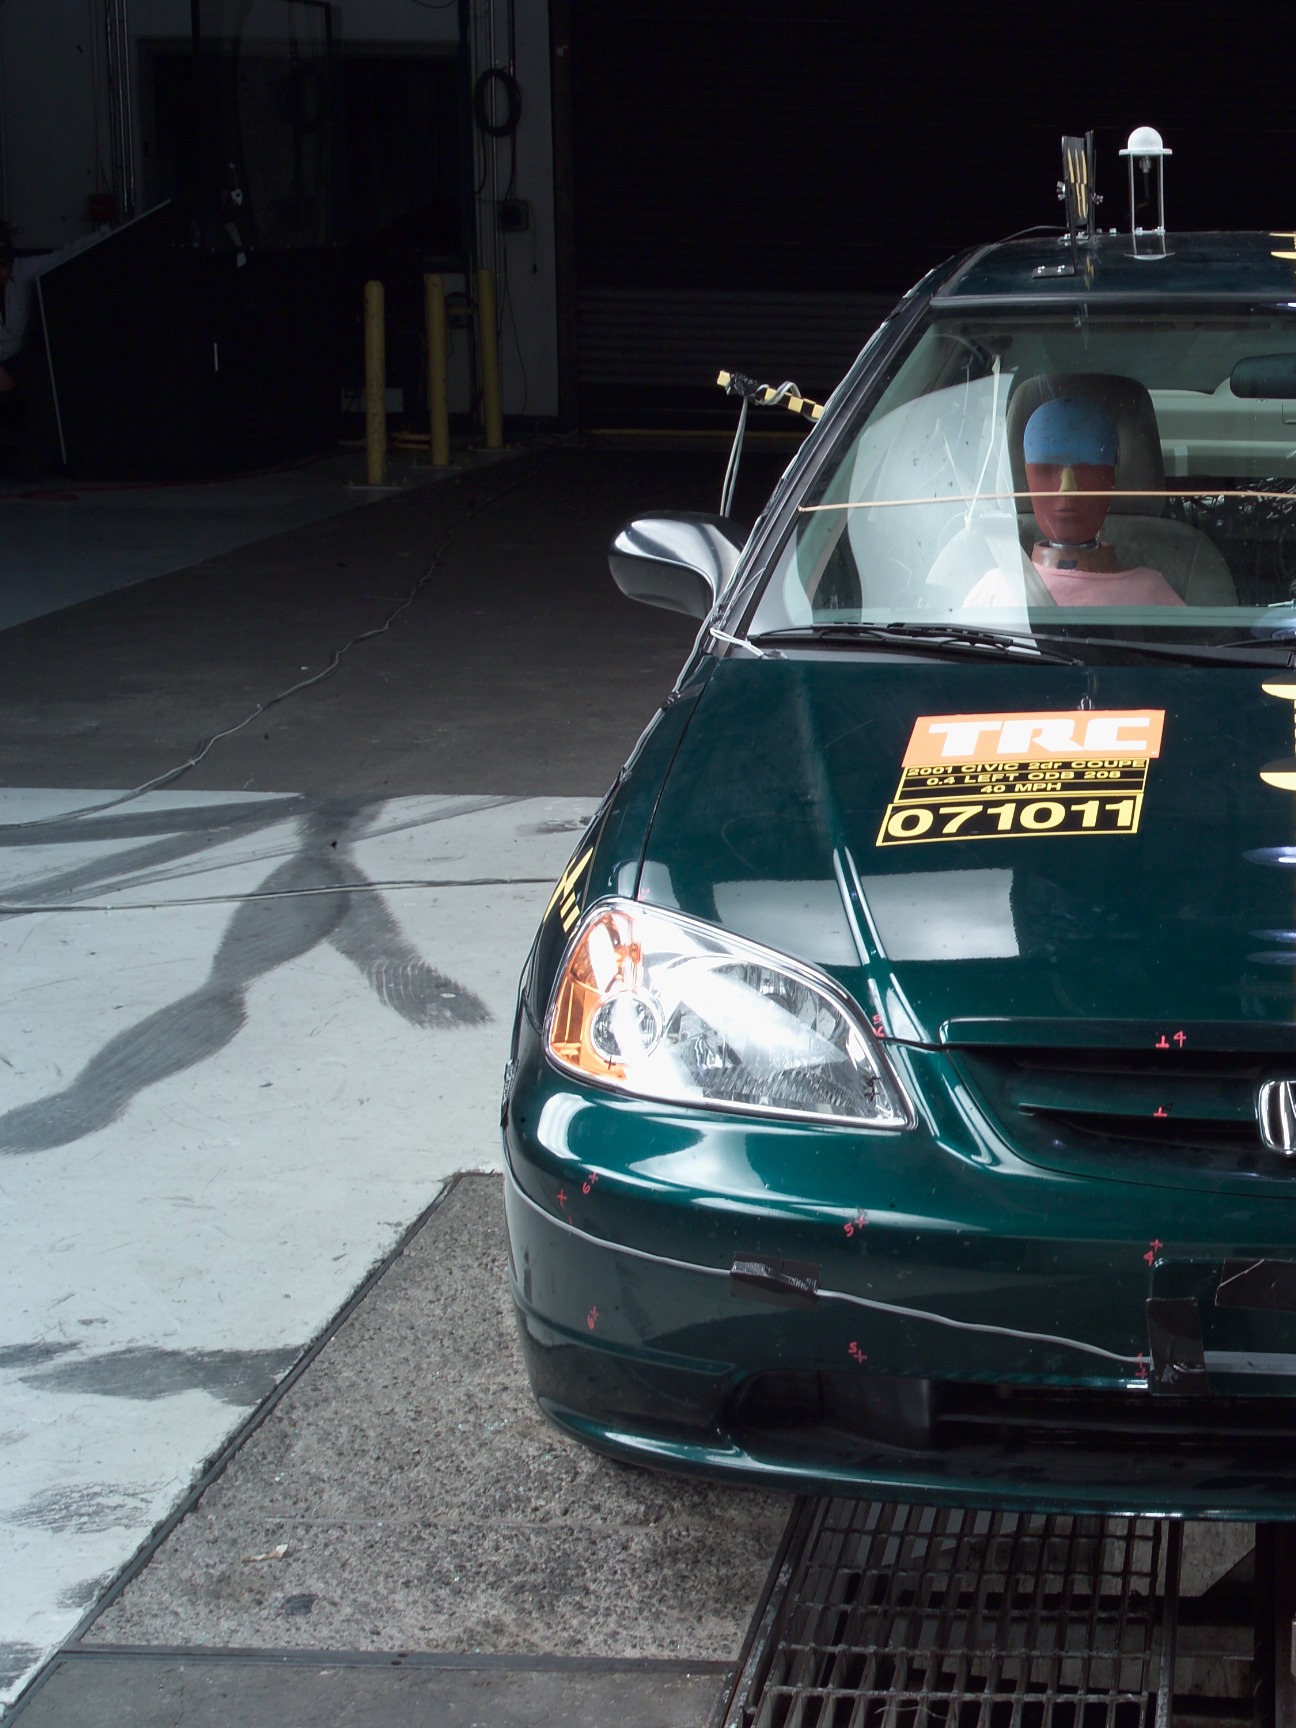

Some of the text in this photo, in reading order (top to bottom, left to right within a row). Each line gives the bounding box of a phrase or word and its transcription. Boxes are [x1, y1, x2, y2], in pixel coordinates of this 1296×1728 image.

[928, 717, 1150, 757] TRC
[907, 759, 1146, 776] 2001 CIVIC 2dr COUPE
[926, 770, 1121, 786] 0.4 LEFT ODB 208
[980, 782, 1061, 793] 40 MPH
[887, 800, 1134, 837] 071011
